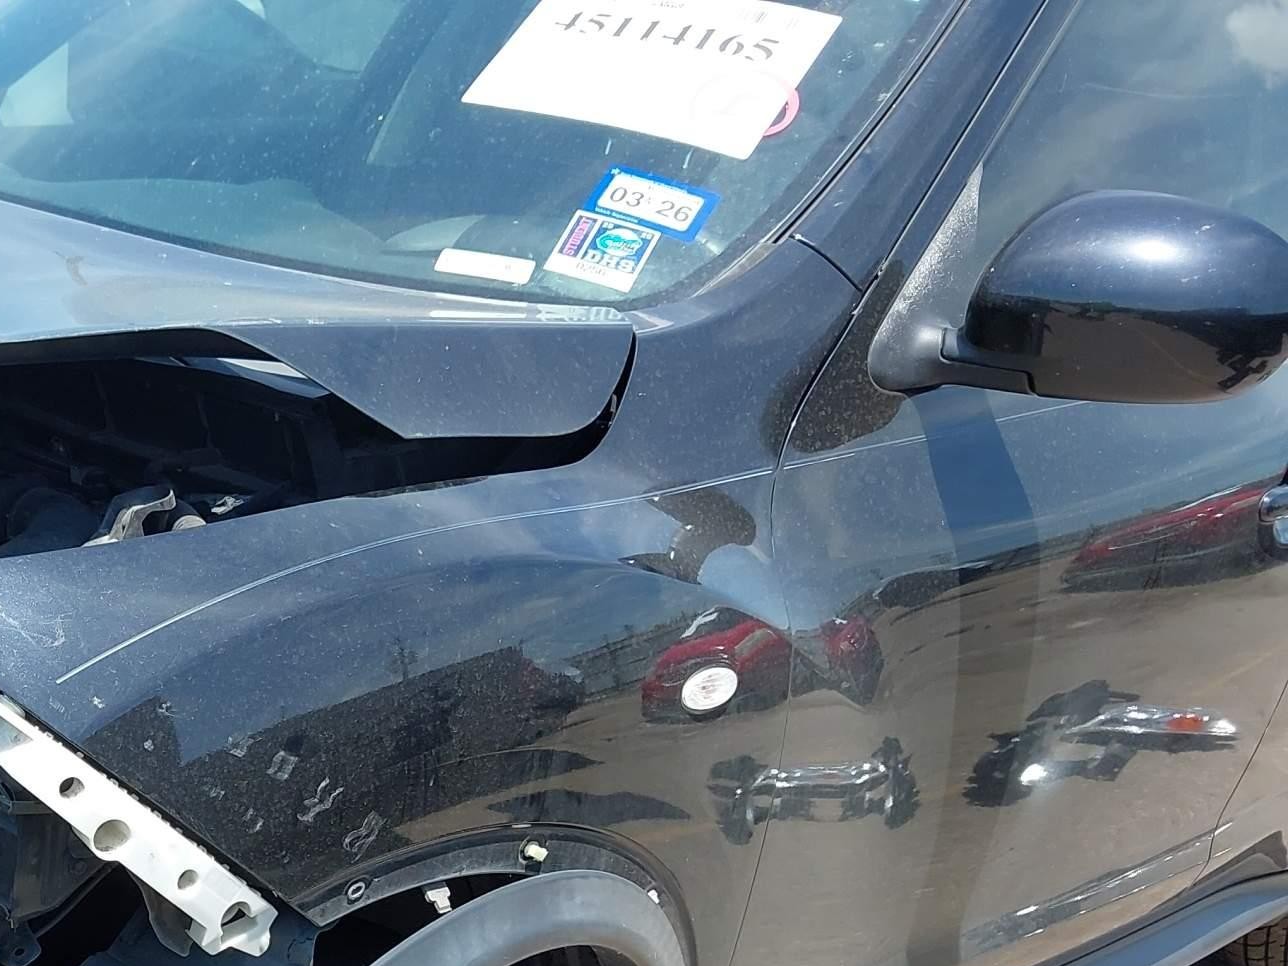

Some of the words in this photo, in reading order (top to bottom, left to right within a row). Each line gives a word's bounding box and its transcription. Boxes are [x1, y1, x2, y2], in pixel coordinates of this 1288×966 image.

[554, 12, 780, 61] 45114165
[609, 186, 645, 208] 03
[655, 200, 692, 222] 26
[583, 248, 636, 273] DHS
